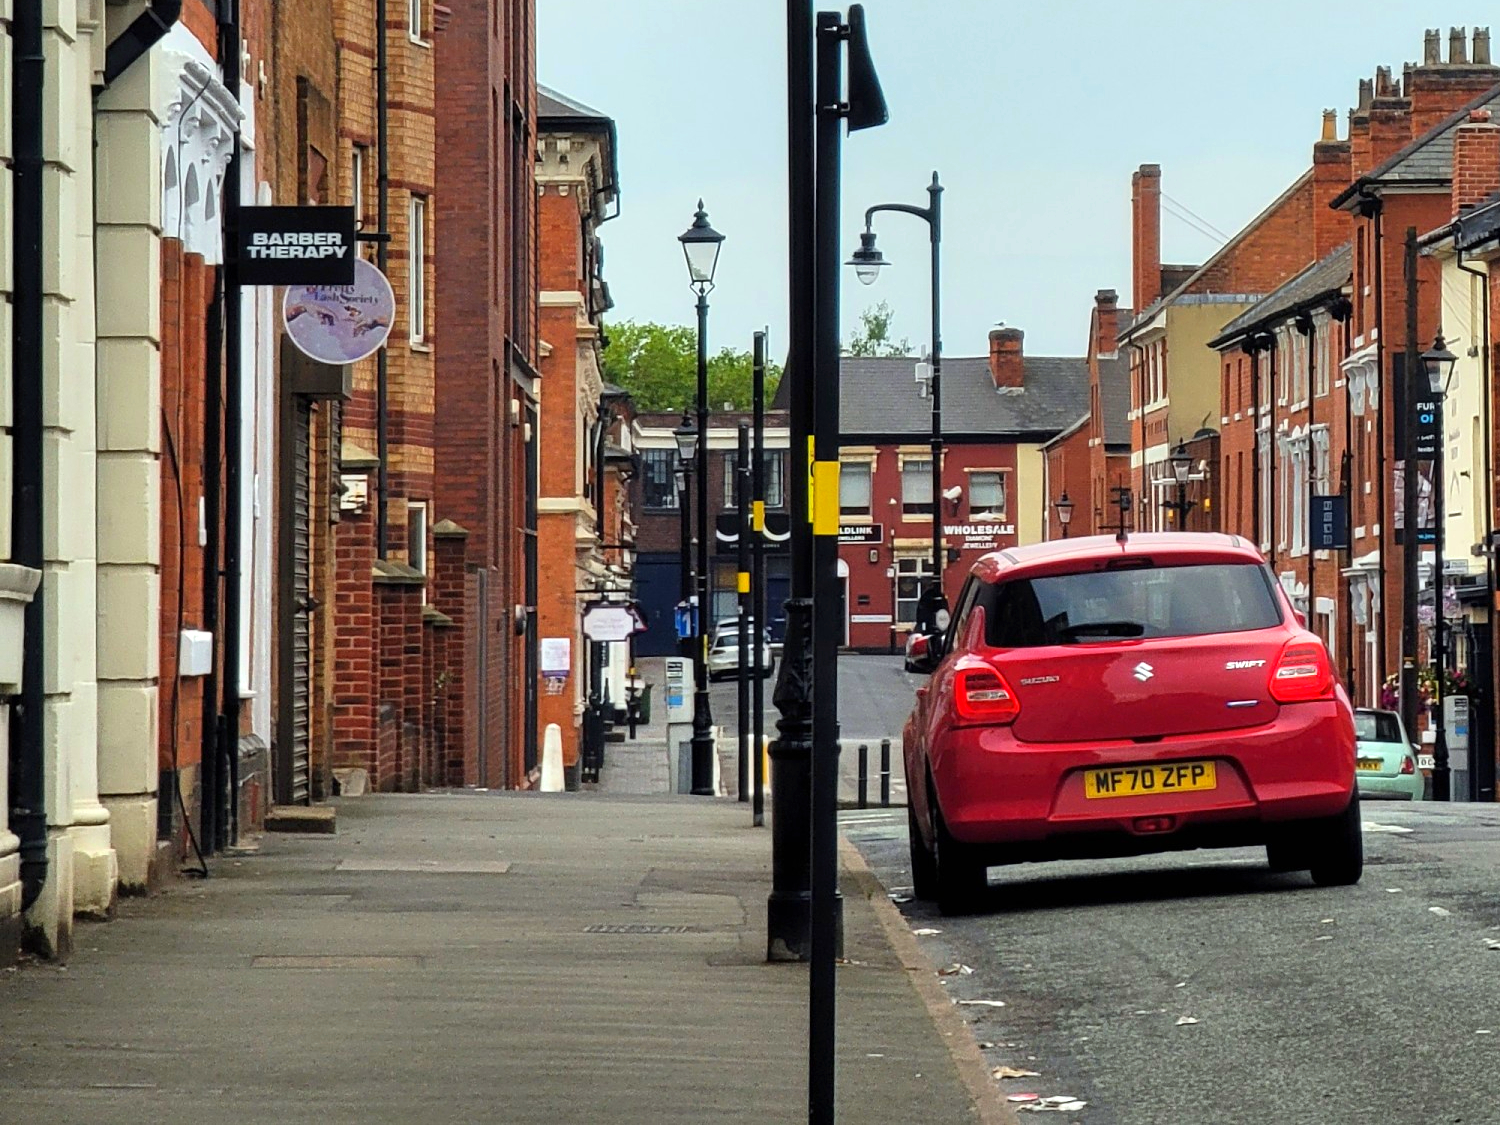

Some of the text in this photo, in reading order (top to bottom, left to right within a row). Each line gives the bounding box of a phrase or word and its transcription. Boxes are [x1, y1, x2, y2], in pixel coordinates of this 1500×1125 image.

[253, 232, 342, 246] BARBER
[247, 245, 348, 259] THERAPY
[839, 526, 873, 535] LDLINK
[944, 524, 1015, 535] WHOLESALE
[1226, 660, 1266, 670] SWIFT
[1096, 764, 1206, 794] MF70 ZFP
